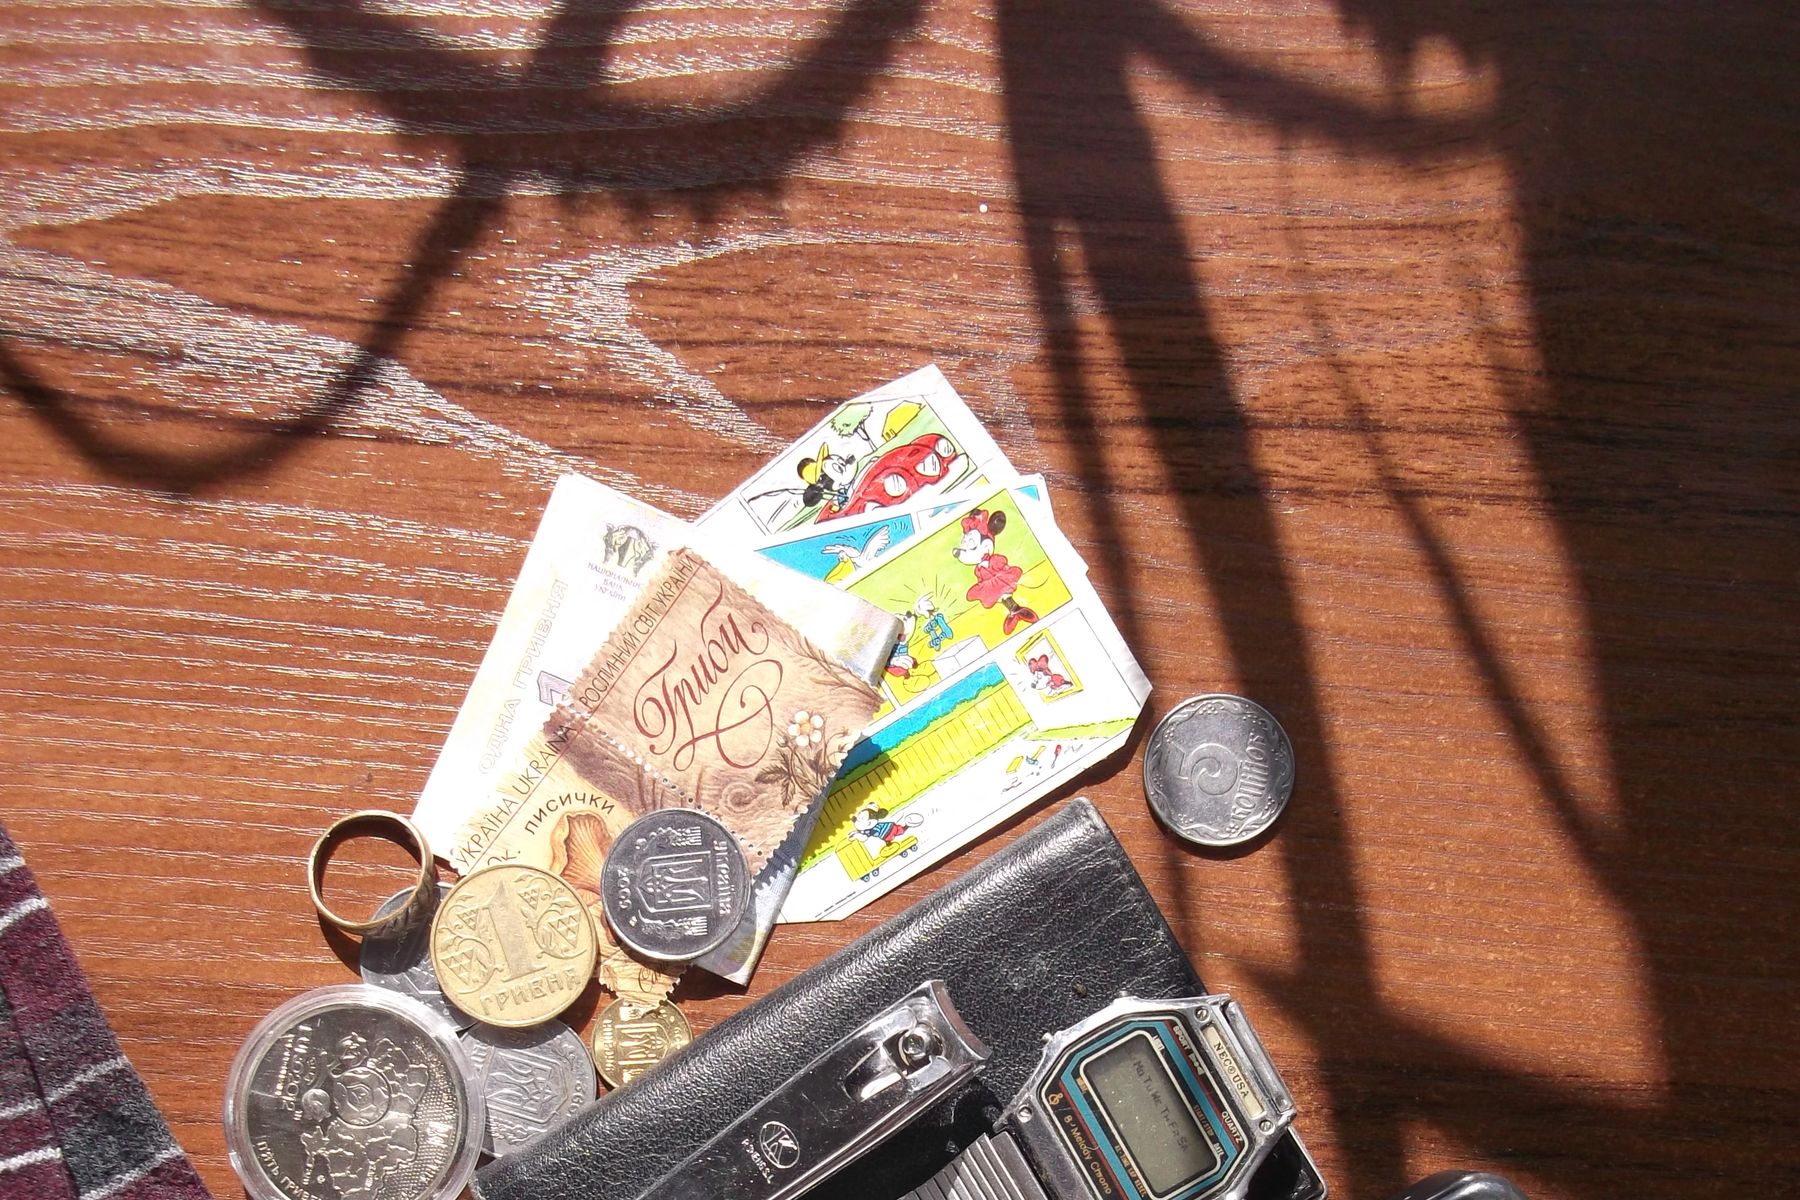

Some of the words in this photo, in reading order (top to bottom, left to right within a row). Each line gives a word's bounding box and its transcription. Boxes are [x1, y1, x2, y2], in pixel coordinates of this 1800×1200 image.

[579, 629, 641, 709] РОСЛИННИЙ
[633, 603, 661, 637] СВІТ
[653, 554, 698, 608] УКРАЇНИ
[455, 797, 519, 867] УКРАЇНА
[1172, 1025, 1192, 1053] SPORT
[1221, 1110, 1243, 1143] QUARTZ
[1090, 1161, 1112, 1195] Chrono
